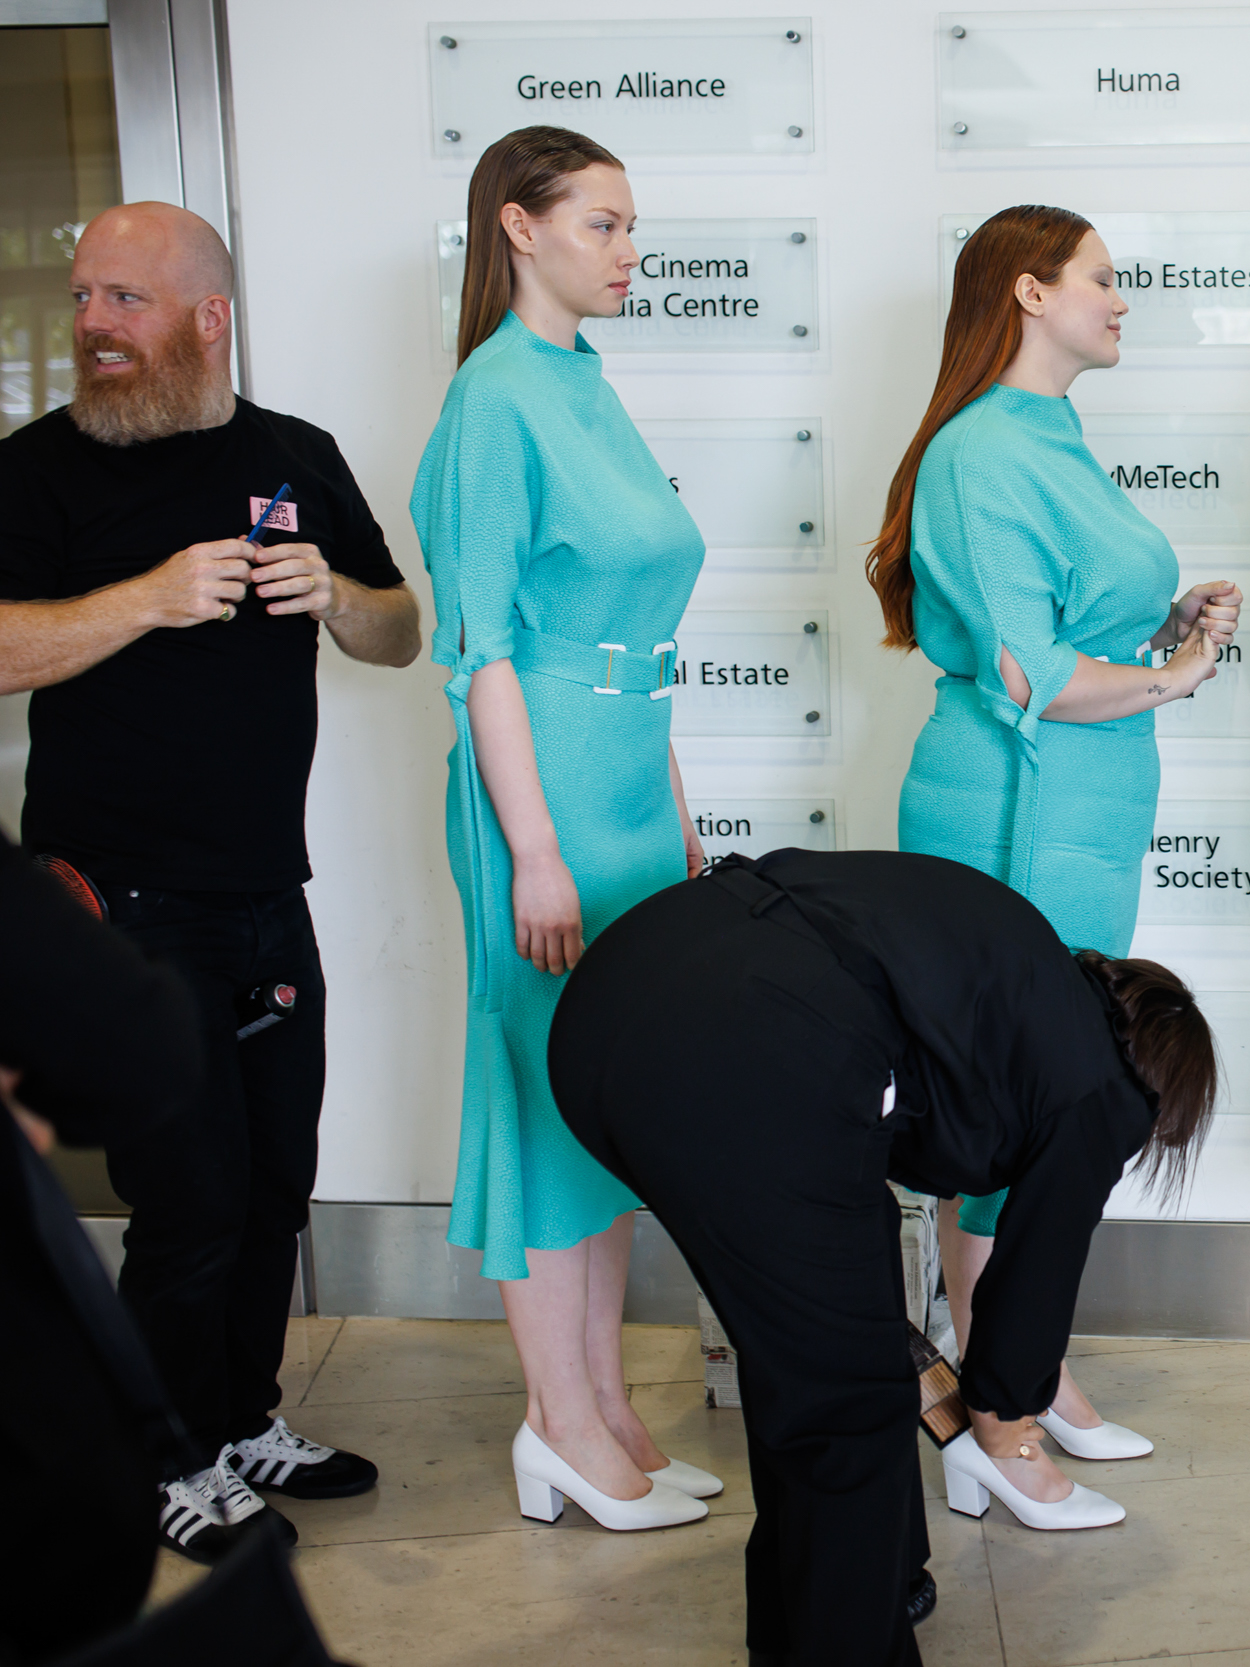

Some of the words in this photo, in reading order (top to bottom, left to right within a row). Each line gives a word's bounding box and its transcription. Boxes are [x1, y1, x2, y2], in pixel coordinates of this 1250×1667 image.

[516, 74, 602, 100] Green
[615, 72, 725, 98] Alliance
[1096, 68, 1180, 93] Huma
[641, 253, 748, 278] Cinema
[664, 293, 759, 317] Centre
[701, 662, 789, 685] Estate
